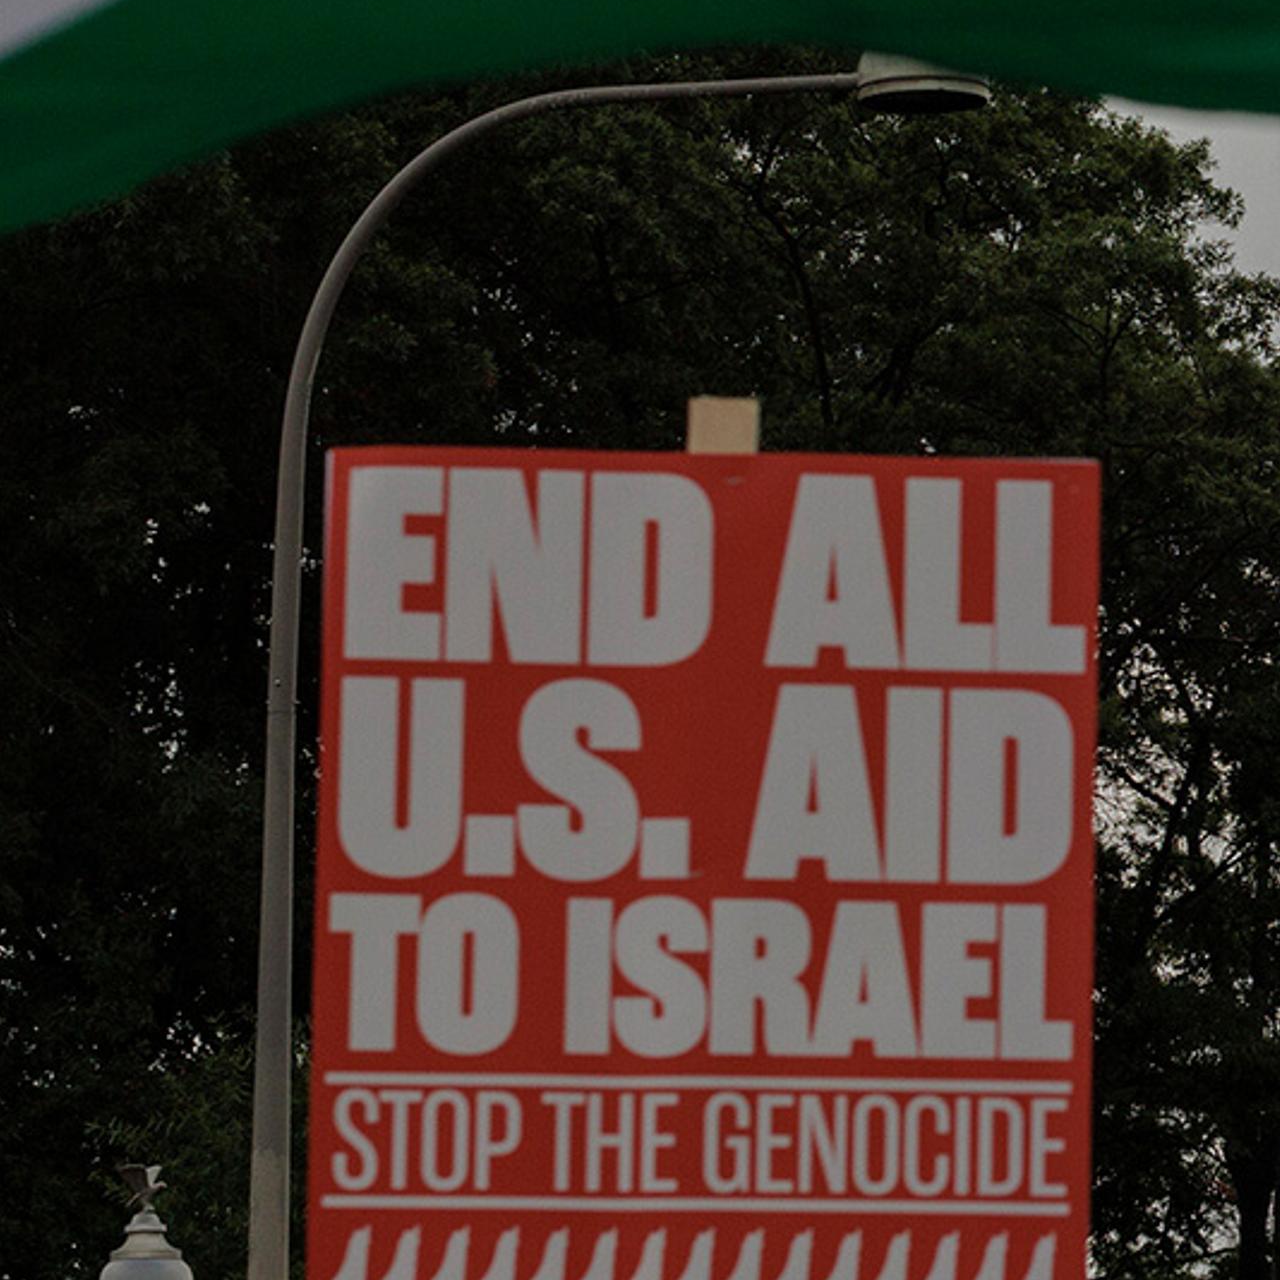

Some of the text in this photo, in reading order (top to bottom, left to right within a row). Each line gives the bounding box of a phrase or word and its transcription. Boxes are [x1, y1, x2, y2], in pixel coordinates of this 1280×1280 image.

[342, 465, 1087, 675] END ALL
[336, 674, 1076, 887] U.S. AID
[328, 891, 1074, 1061] TO ISRAEL
[329, 1084, 1071, 1200] STOP THE GENOCIDE
